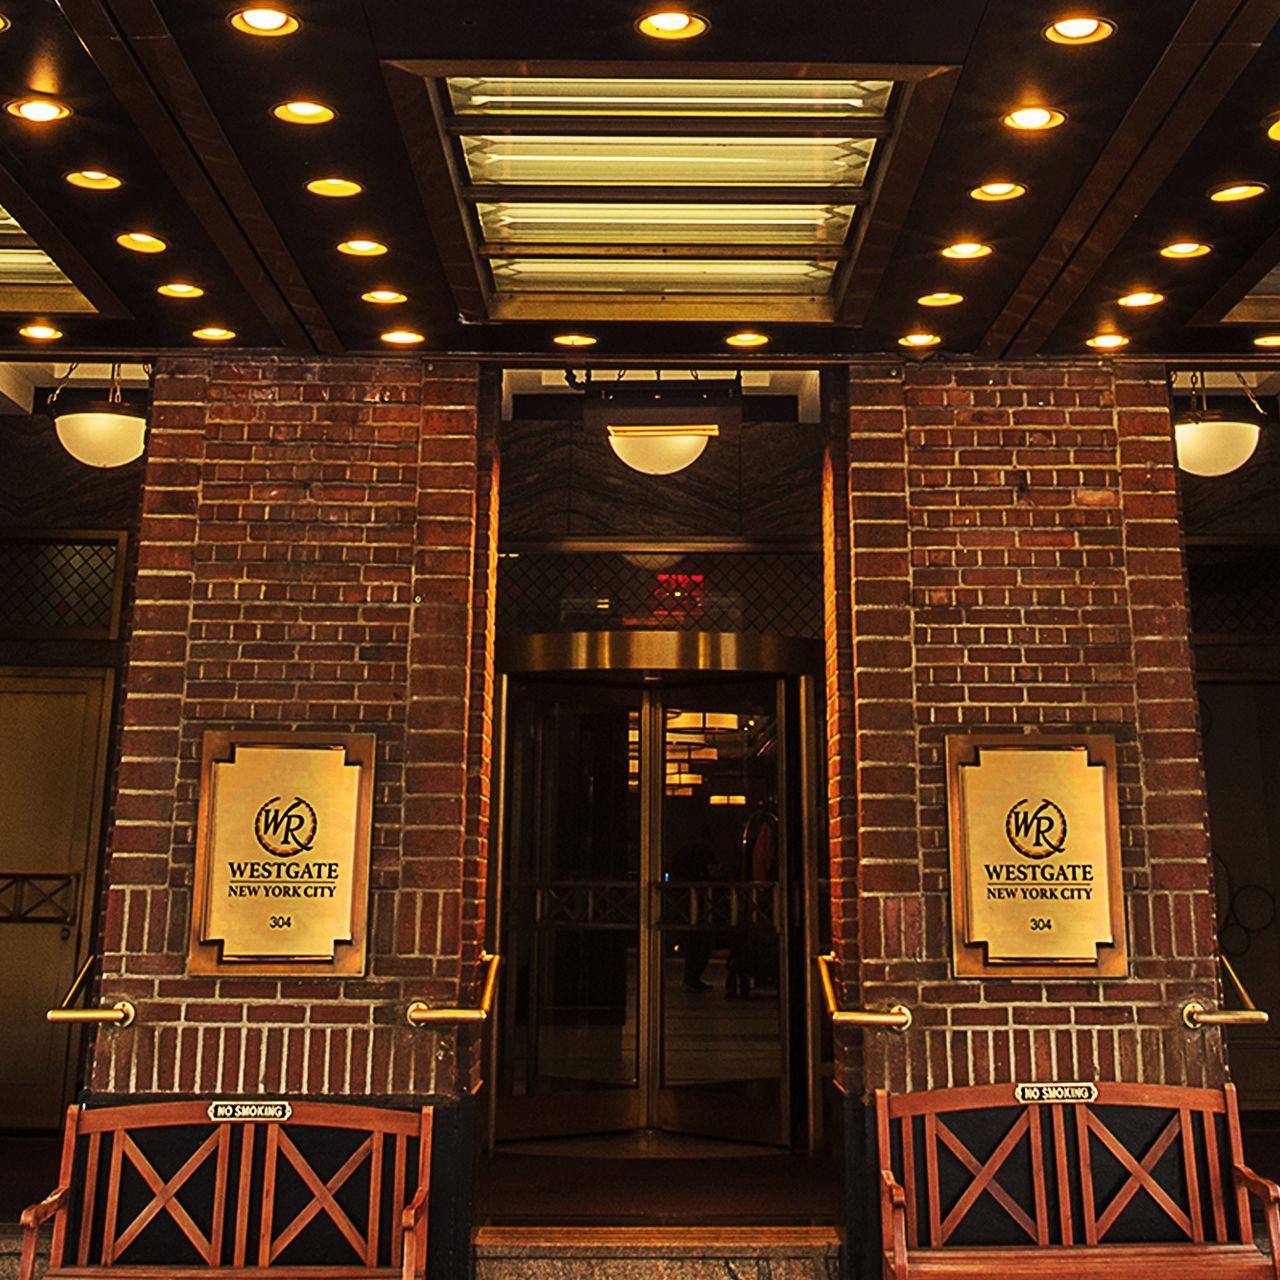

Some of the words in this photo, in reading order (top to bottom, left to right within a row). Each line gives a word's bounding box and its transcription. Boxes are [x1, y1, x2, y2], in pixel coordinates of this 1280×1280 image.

[261, 797, 314, 853] WR
[1012, 799, 1065, 855] WR
[228, 862, 339, 880] WESTGATE
[984, 864, 1094, 882] WESTGATE
[228, 885, 259, 898] NEW
[263, 885, 301, 898] YORK
[303, 885, 337, 898] CITY
[987, 887, 1018, 900] NEW
[1021, 887, 1058, 900] YORK
[1060, 887, 1093, 900] CITY
[269, 916, 292, 929] 304
[1030, 918, 1052, 931] 304
[1024, 1087, 1040, 1099] NO
[1042, 1087, 1089, 1099] SMOKING
[217, 1105, 233, 1117] NO
[235, 1105, 283, 1117] SMOKING
